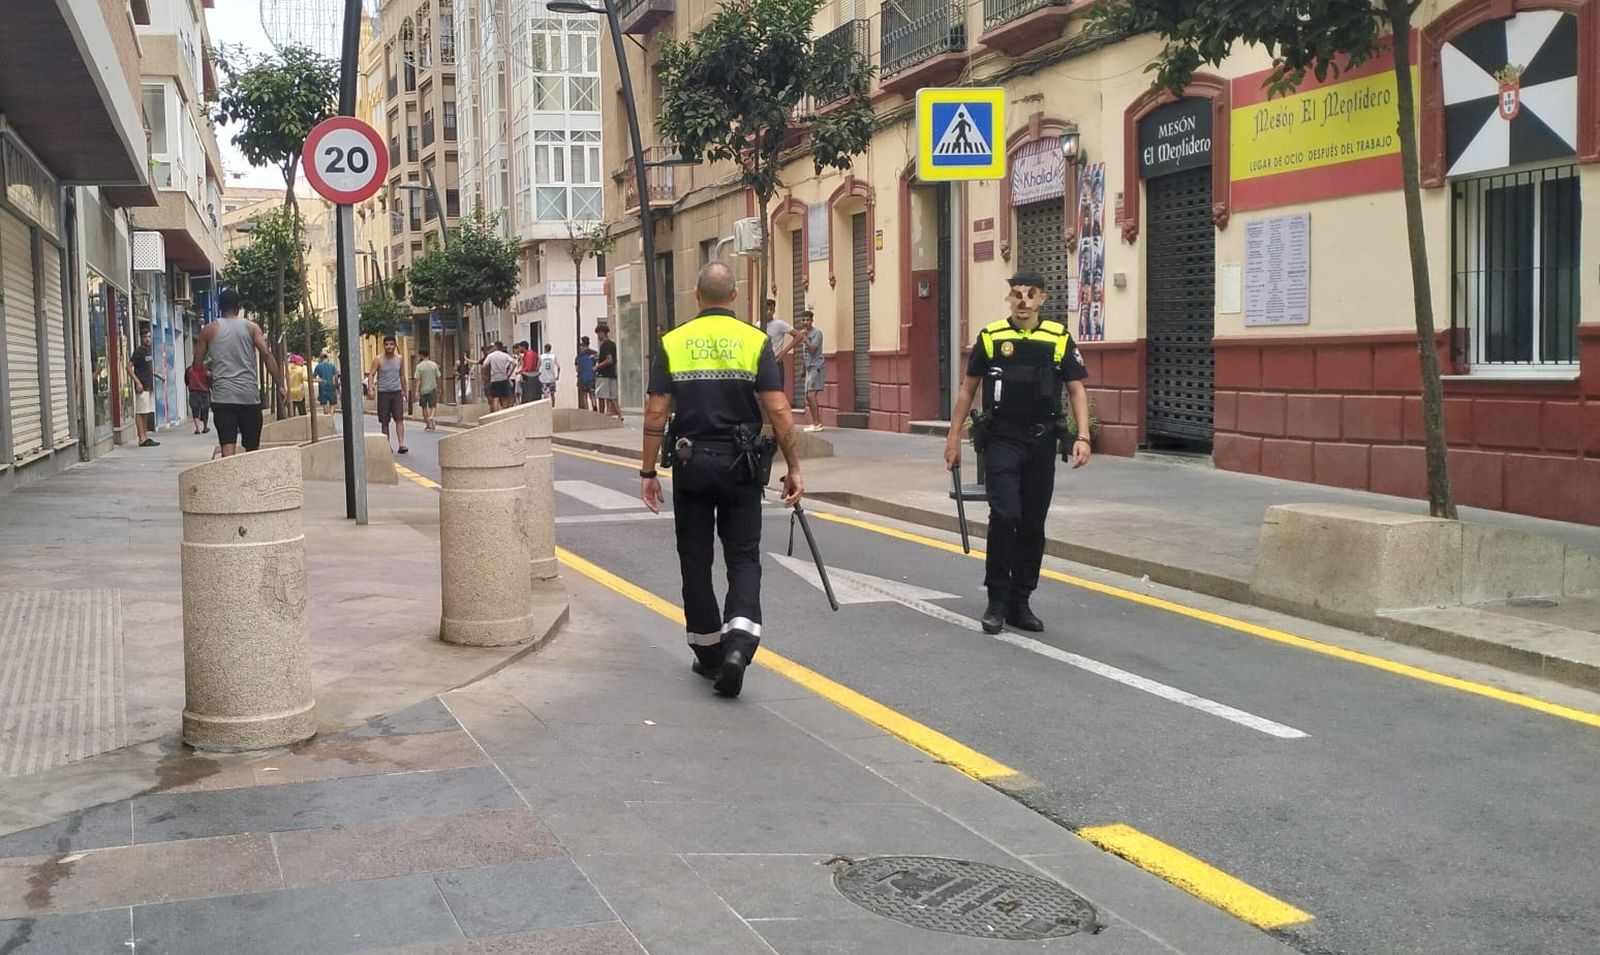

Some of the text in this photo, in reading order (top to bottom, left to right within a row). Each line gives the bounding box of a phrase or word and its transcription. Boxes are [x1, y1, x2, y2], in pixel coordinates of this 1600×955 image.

[1301, 99, 1316, 124] El
[1321, 86, 1391, 126] Mentidero
[1158, 116, 1196, 139] MESÓN
[325, 147, 369, 173] 20
[1143, 134, 1211, 166] El Mentidero
[1250, 135, 1393, 172] LUGAR DE OCIO DESPUÉS DEL TRABAJO
[691, 348, 736, 360] LOCAL
